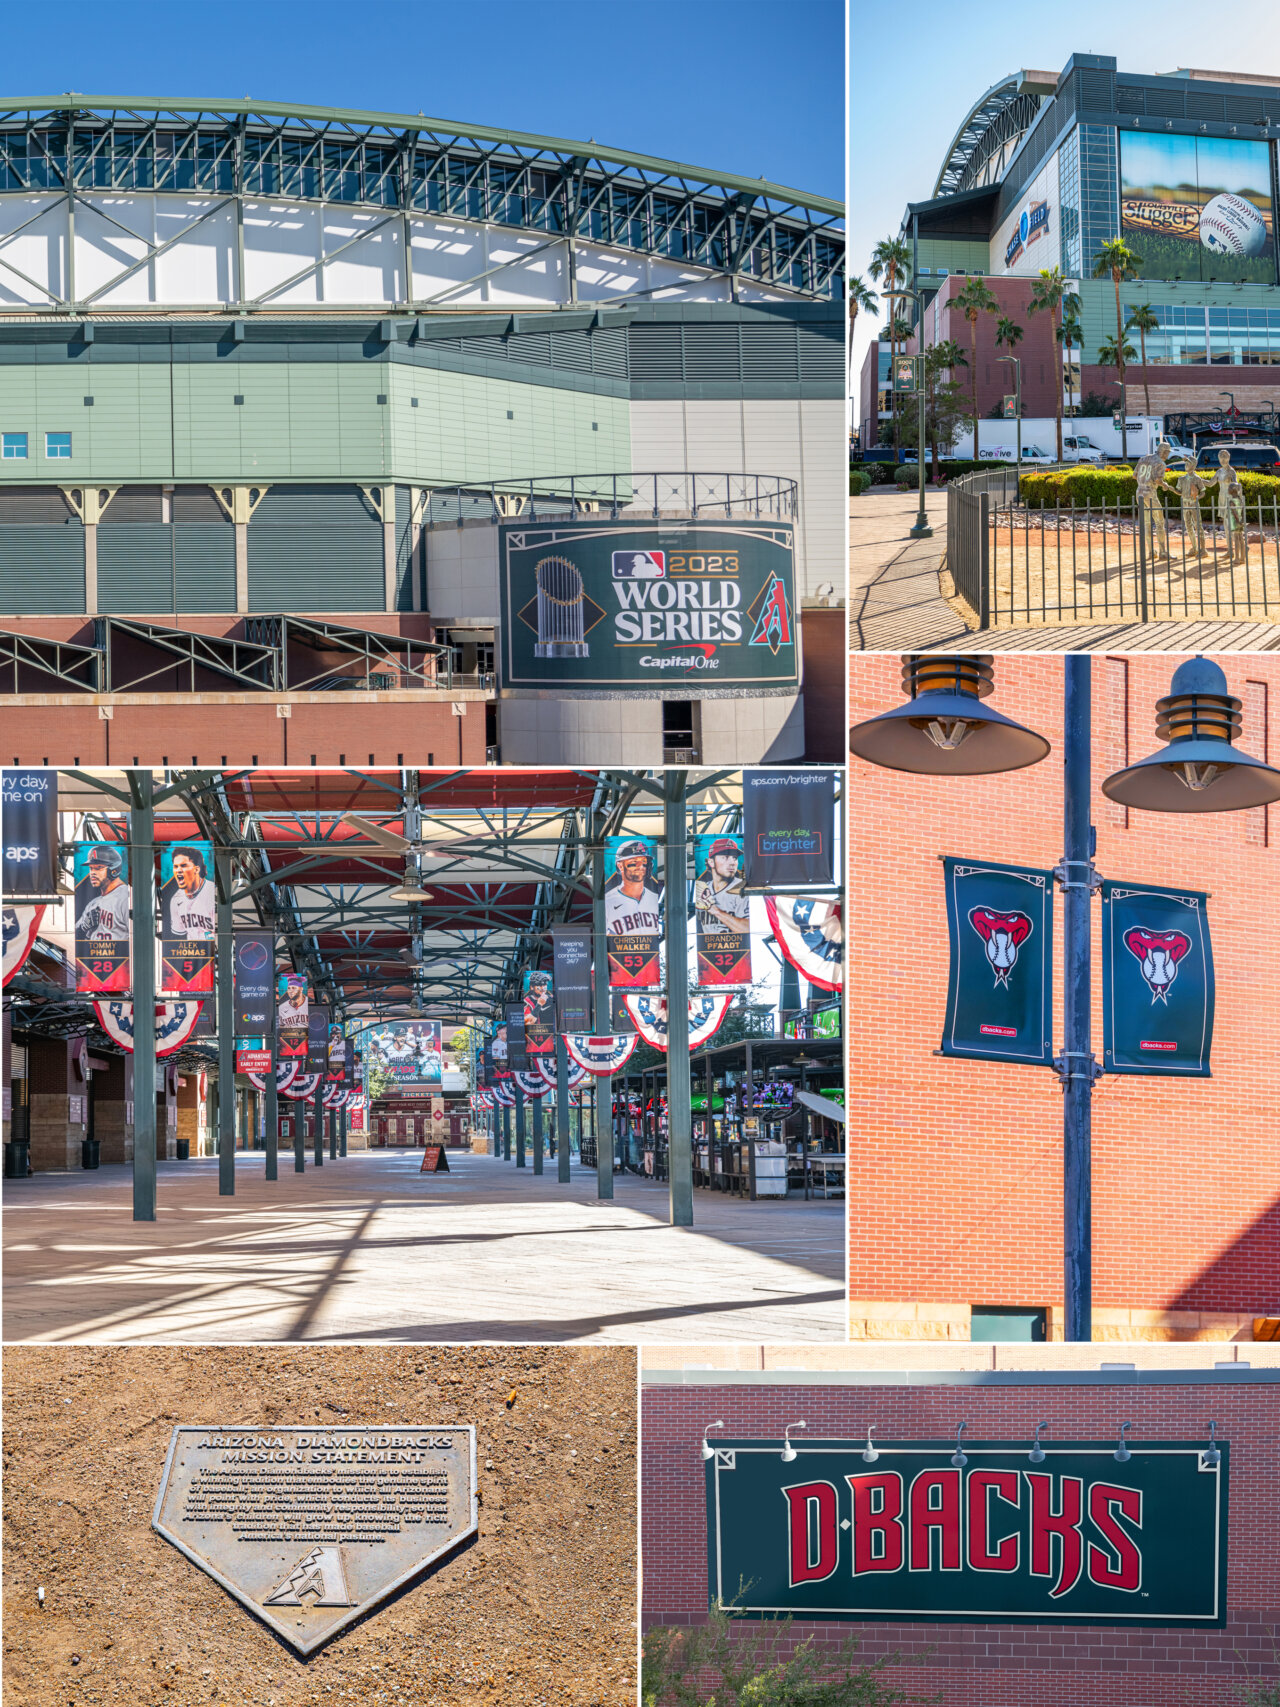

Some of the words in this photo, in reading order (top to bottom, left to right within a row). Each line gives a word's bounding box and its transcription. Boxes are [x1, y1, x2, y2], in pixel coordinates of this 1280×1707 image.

[1140, 202, 1189, 213] LOUISVILLE
[1125, 202, 1191, 228] Slugger
[1139, 465, 1152, 481] 98
[670, 556, 739, 572] 2023
[612, 581, 741, 610] WORLD
[614, 611, 743, 642] SERIES
[20, 774, 49, 790] day,
[751, 774, 828, 788] aps.com/brighter
[23, 791, 43, 802] on
[768, 830, 792, 838] every
[763, 837, 816, 852] brighter
[6, 846, 39, 863] aps
[613, 936, 652, 944] CHRISTIAN
[704, 935, 743, 943] BRANDON
[616, 943, 651, 951] WALKER
[707, 941, 740, 950] PFAADT
[623, 955, 644, 968] 53
[714, 954, 734, 966] 32
[93, 961, 113, 973] 28
[183, 961, 193, 973] 5
[240, 985, 256, 993] Every
[251, 1014, 265, 1022] aps
[981, 1026, 1016, 1036] dbacks.com
[1142, 1042, 1176, 1050] dbacks.com
[198, 1437, 285, 1449] ARIZONA
[297, 1437, 453, 1449] DIAMONDBACKS
[222, 1451, 304, 1463] MISSION
[311, 1451, 425, 1463] STATEMENT
[200, 1467, 220, 1476] The
[221, 1467, 257, 1476] Arizona
[337, 1468, 376, 1477] mission
[379, 1468, 387, 1477] is
[389, 1468, 399, 1477] to
[401, 1468, 448, 1477] establish
[200, 1477, 239, 1486] winning
[241, 1477, 285, 1486] tradition
[287, 1477, 306, 1486] that
[307, 1478, 357, 1487] embodies
[358, 1478, 376, 1487] the
[377, 1478, 418, 1487] genuine
[420, 1478, 448, 1487] spirit
[189, 1486, 200, 1495] of
[251, 1486, 264, 1495] an
[267, 1486, 330, 1495] organization
[332, 1487, 343, 1496] to
[346, 1487, 376, 1496] which
[379, 1487, 391, 1496] all
[394, 1487, 448, 1496] Arizonans
[188, 1495, 206, 1504] will
[209, 1495, 236, 1504] point
[238, 1495, 260, 1504] with
[296, 1495, 327, 1504] which
[331, 1496, 380, 1505] conducts
[382, 1496, 396, 1505] its
[400, 1496, 448, 1505] business
[186, 1505, 208, 1513] with
[209, 1505, 252, 1513] integrity
[253, 1505, 273, 1513] and
[275, 1505, 332, 1513] community
[410, 1506, 424, 1514] so
[426, 1506, 448, 1514] that
[182, 1513, 232, 1521] Arizona's
[235, 1514, 279, 1522] children
[283, 1514, 301, 1522] will
[305, 1514, 333, 1522] grow
[337, 1514, 351, 1522] up
[355, 1514, 400, 1522] knowing
[404, 1515, 422, 1523] the
[425, 1515, 448, 1523] rich
[232, 1523, 277, 1532] tradition
[279, 1523, 300, 1532] that
[302, 1523, 321, 1532] has
[324, 1524, 353, 1533] made
[355, 1524, 401, 1533] baseball
[237, 1532, 291, 1541] America's
[294, 1532, 337, 1541] national
[339, 1533, 386, 1542] pastime.
